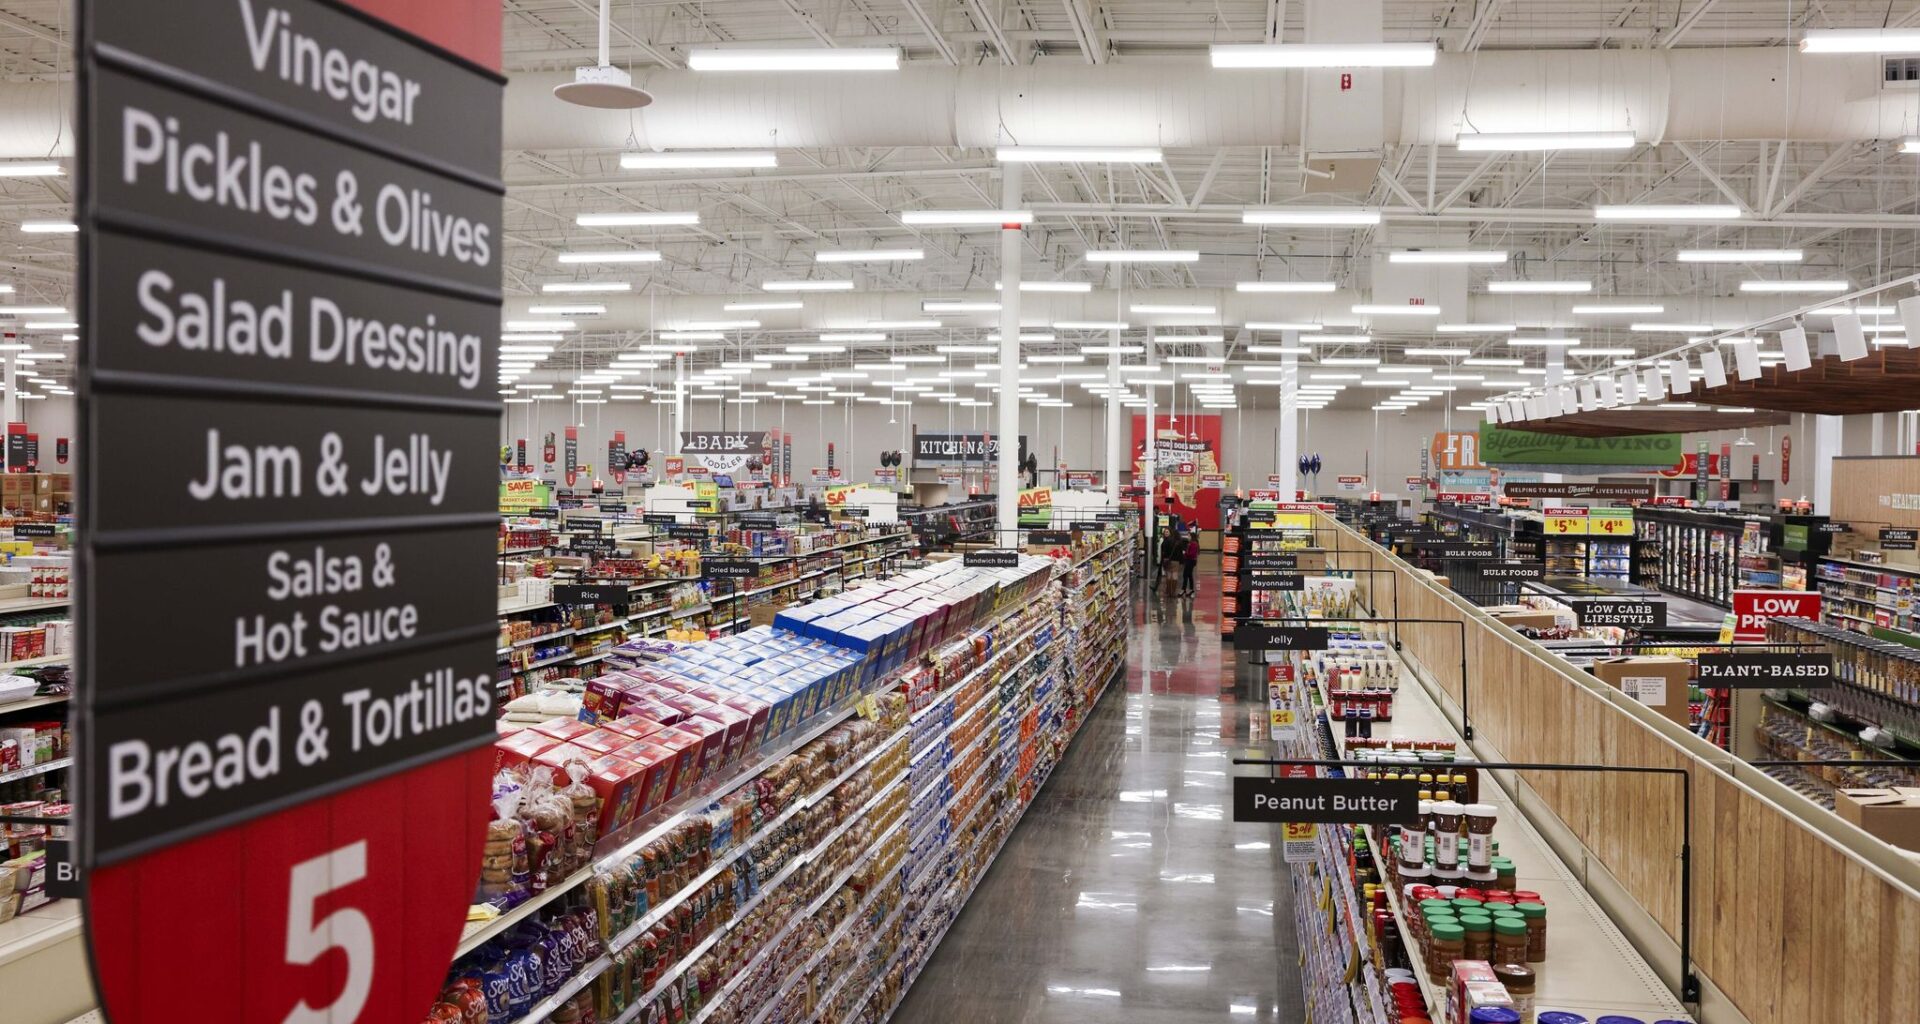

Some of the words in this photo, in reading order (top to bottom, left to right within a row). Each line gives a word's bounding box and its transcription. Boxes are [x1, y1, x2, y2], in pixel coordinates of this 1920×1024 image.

[239, 0, 421, 125] Vinegar
[122, 106, 319, 227] Pickles
[331, 169, 363, 237] &
[375, 183, 491, 268] Olives
[136, 269, 294, 360] Salad
[309, 296, 482, 390] Dressing
[697, 435, 749, 450] BABY
[1575, 437, 1673, 451] LIVING
[188, 428, 301, 501] Jam
[315, 432, 349, 496] &
[360, 433, 453, 506] Jelly
[703, 455, 743, 470] TODDLER
[507, 481, 533, 491] SAVE!
[1018, 489, 1051, 507] AVE!
[267, 546, 363, 601] Salsa
[371, 542, 396, 590] &
[1483, 569, 1507, 577] BULK
[1509, 569, 1539, 577] FOODS
[1251, 579, 1294, 589] Mayonnaise
[581, 592, 600, 600] Rice
[1586, 605, 1616, 614] LOW
[1619, 605, 1652, 614] CARB
[1753, 599, 1800, 613] LOW
[1583, 614, 1655, 624] LIFESTYLE
[235, 611, 307, 668] Hot
[319, 602, 420, 653] Sauce
[1267, 635, 1293, 646] Jelly
[1700, 665, 1830, 677] PLANT-BASED
[108, 706, 281, 820] Bread
[295, 699, 331, 767] &
[342, 667, 492, 753] Tortillas
[1254, 794, 1326, 811] Peanut
[1333, 794, 1398, 811] Butter
[282, 838, 375, 1024] 5
